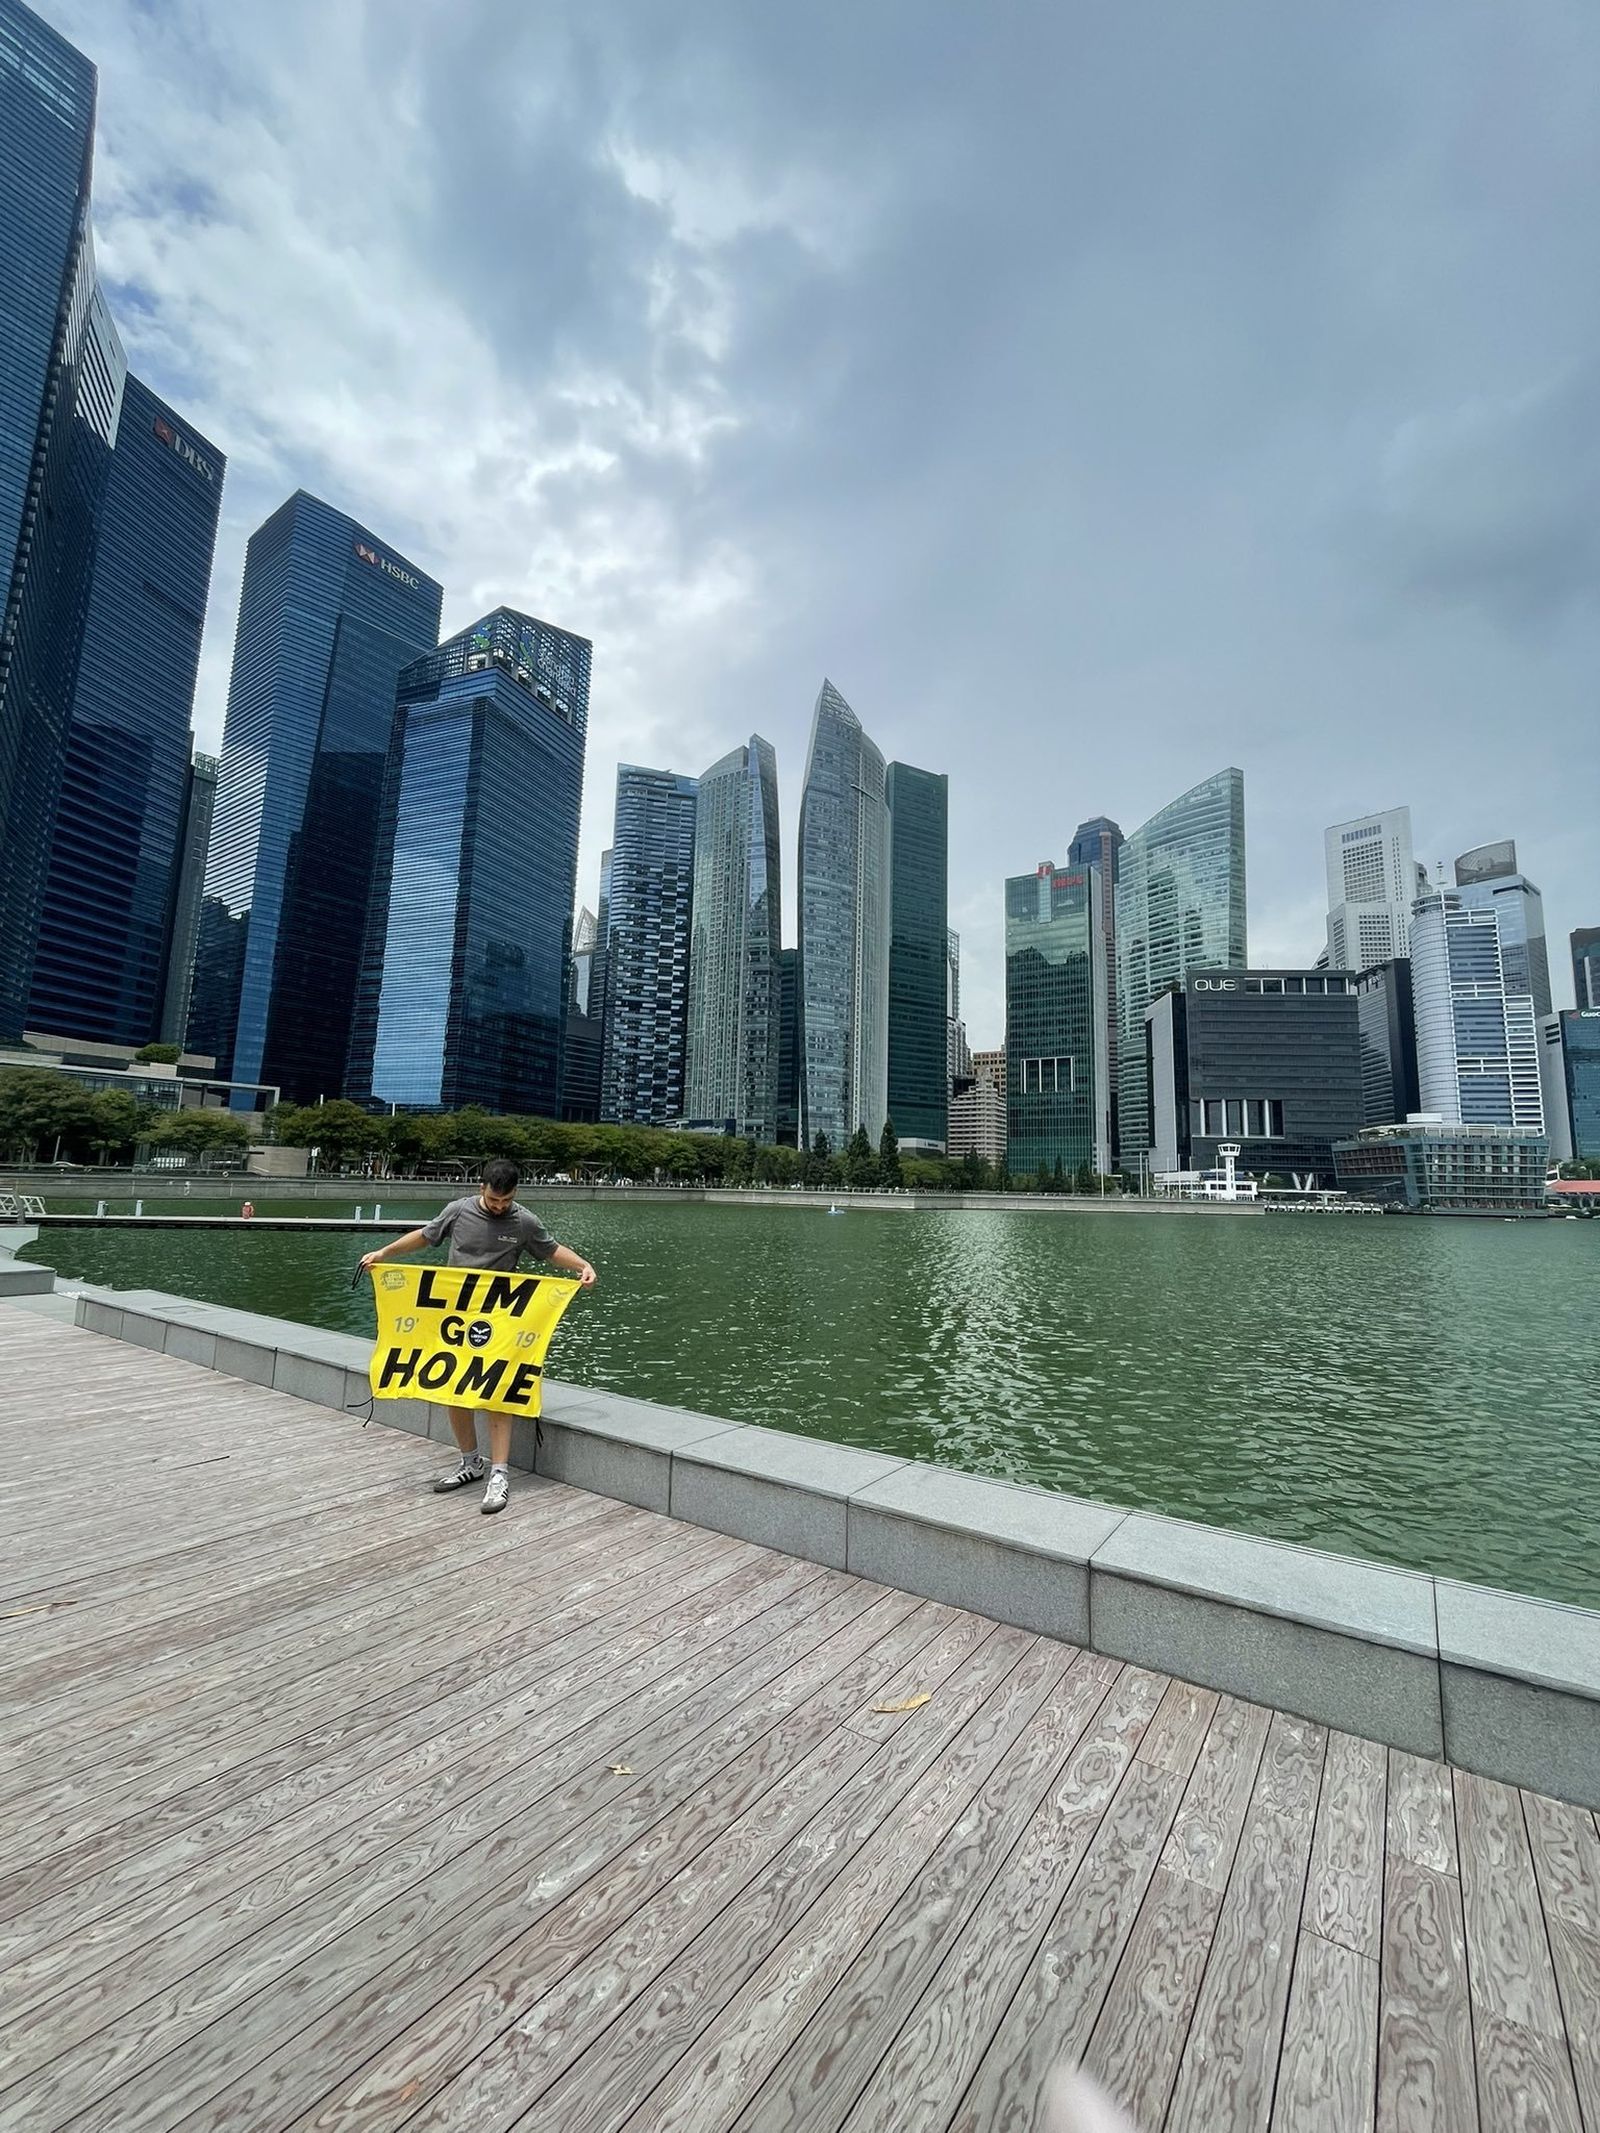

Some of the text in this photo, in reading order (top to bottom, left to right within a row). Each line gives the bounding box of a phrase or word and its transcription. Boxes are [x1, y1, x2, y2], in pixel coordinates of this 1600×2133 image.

[174, 435, 213, 480] DBS
[380, 559, 419, 590] HSBC
[1194, 979, 1236, 991] OUE
[416, 1270, 541, 1317] LIM
[378, 1347, 543, 1405] HOME
